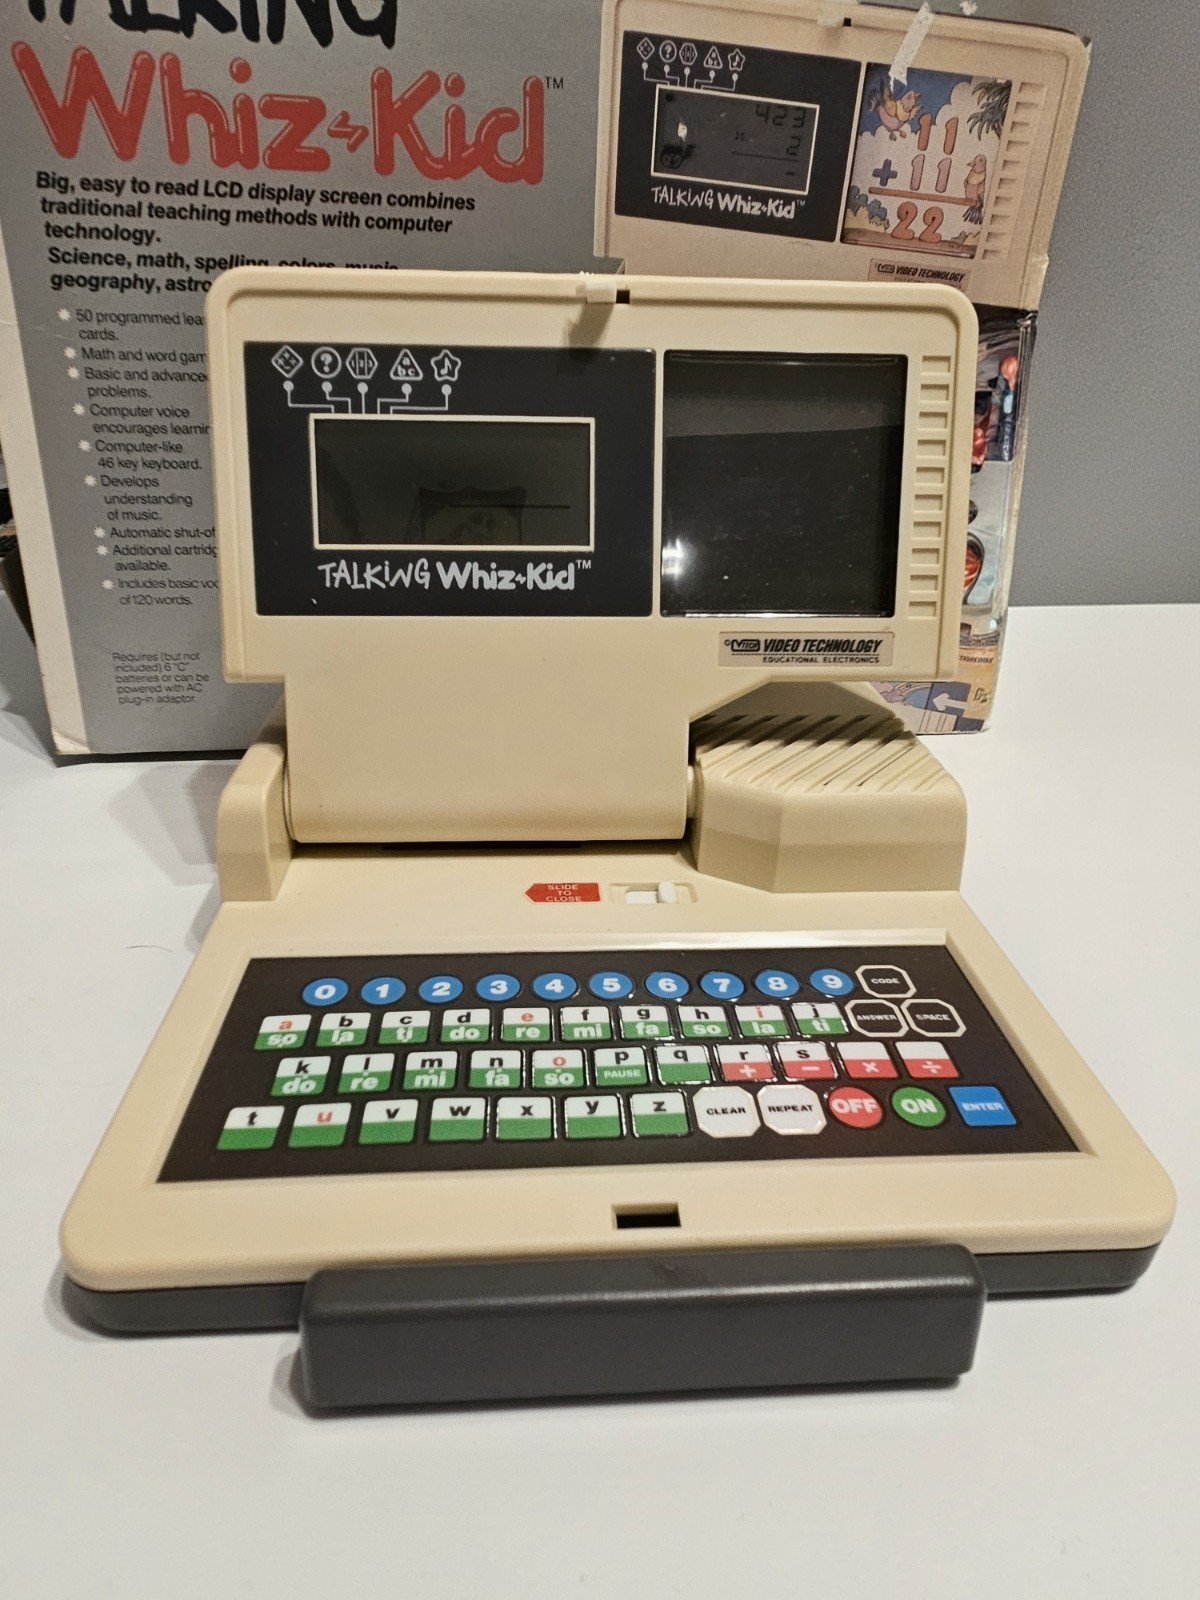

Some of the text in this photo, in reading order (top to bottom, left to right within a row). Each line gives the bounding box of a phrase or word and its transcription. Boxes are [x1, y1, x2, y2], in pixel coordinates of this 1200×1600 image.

[36, 171, 476, 210] Big, easy to read LCD display screen combines
[651, 185, 714, 210] TALKING
[41, 197, 453, 234] traditional teaching methods with computer
[891, 201, 944, 244] 22
[44, 221, 162, 246] technology.
[48, 247, 190, 271] Science, math,
[896, 265, 919, 277] VIDEO
[918, 268, 967, 283] TECHNOLOGY
[50, 273, 212, 294] geography, astro
[75, 308, 181, 326] 50 programmed
[79, 328, 119, 341] cards.
[81, 346, 115, 361] Math
[118, 348, 142, 361] and
[146, 349, 177, 362] word
[84, 366, 120, 380] Basic
[124, 367, 148, 381] and
[87, 384, 151, 399] problems.
[89, 403, 190, 419] Computer voice
[92, 423, 168, 437] encourages
[95, 439, 183, 454] Computer-like
[98, 456, 202, 471] 46 key keyboard.
[100, 474, 160, 489] Develops
[103, 493, 193, 507] understanding
[107, 509, 162, 520] of music.
[109, 527, 172, 539] Automatic
[112, 544, 172, 556] Additional
[114, 560, 172, 571] available.
[317, 557, 431, 590] TALKING
[117, 578, 167, 589] Includes
[168, 578, 199, 589] basic
[763, 639, 802, 653] VIDEO
[802, 639, 883, 653] TECHNOLOGY
[762, 656, 880, 664] EDUCATIONAL ELECTRONICS
[314, 984, 336, 999] 0
[375, 983, 390, 998] 1
[431, 981, 451, 996] 2
[489, 980, 508, 995] 3
[545, 978, 564, 993] 4
[602, 977, 621, 992] 5
[657, 977, 678, 993] 6
[712, 978, 731, 993] 7
[767, 976, 788, 991] 8
[821, 974, 843, 990] 9
[278, 1019, 293, 1030] a
[338, 1015, 353, 1027] b
[399, 1015, 412, 1025] c
[456, 1011, 471, 1024] d
[520, 1012, 534, 1022] e
[581, 1008, 590, 1021] f
[637, 1008, 650, 1020] g
[695, 1008, 710, 1020] h
[449, 1026, 480, 1039] do
[515, 1026, 541, 1039] re
[573, 1024, 603, 1038] mi
[635, 1022, 660, 1036] fa
[692, 1023, 722, 1034] so
[752, 1021, 776, 1034] la
[811, 1018, 831, 1032] ti
[295, 1059, 312, 1074] k
[420, 1057, 443, 1068] m
[489, 1056, 504, 1067] n
[552, 1056, 567, 1066] o
[614, 1050, 630, 1064] p
[673, 1049, 688, 1062] q
[739, 1050, 749, 1060] r
[796, 1049, 810, 1059] s
[281, 1069, 641, 1092] do re mi fa so PAUSE
[247, 1098, 1004, 1125] t u v w x y z CLEAR REPEAT OFF ON ENTER
